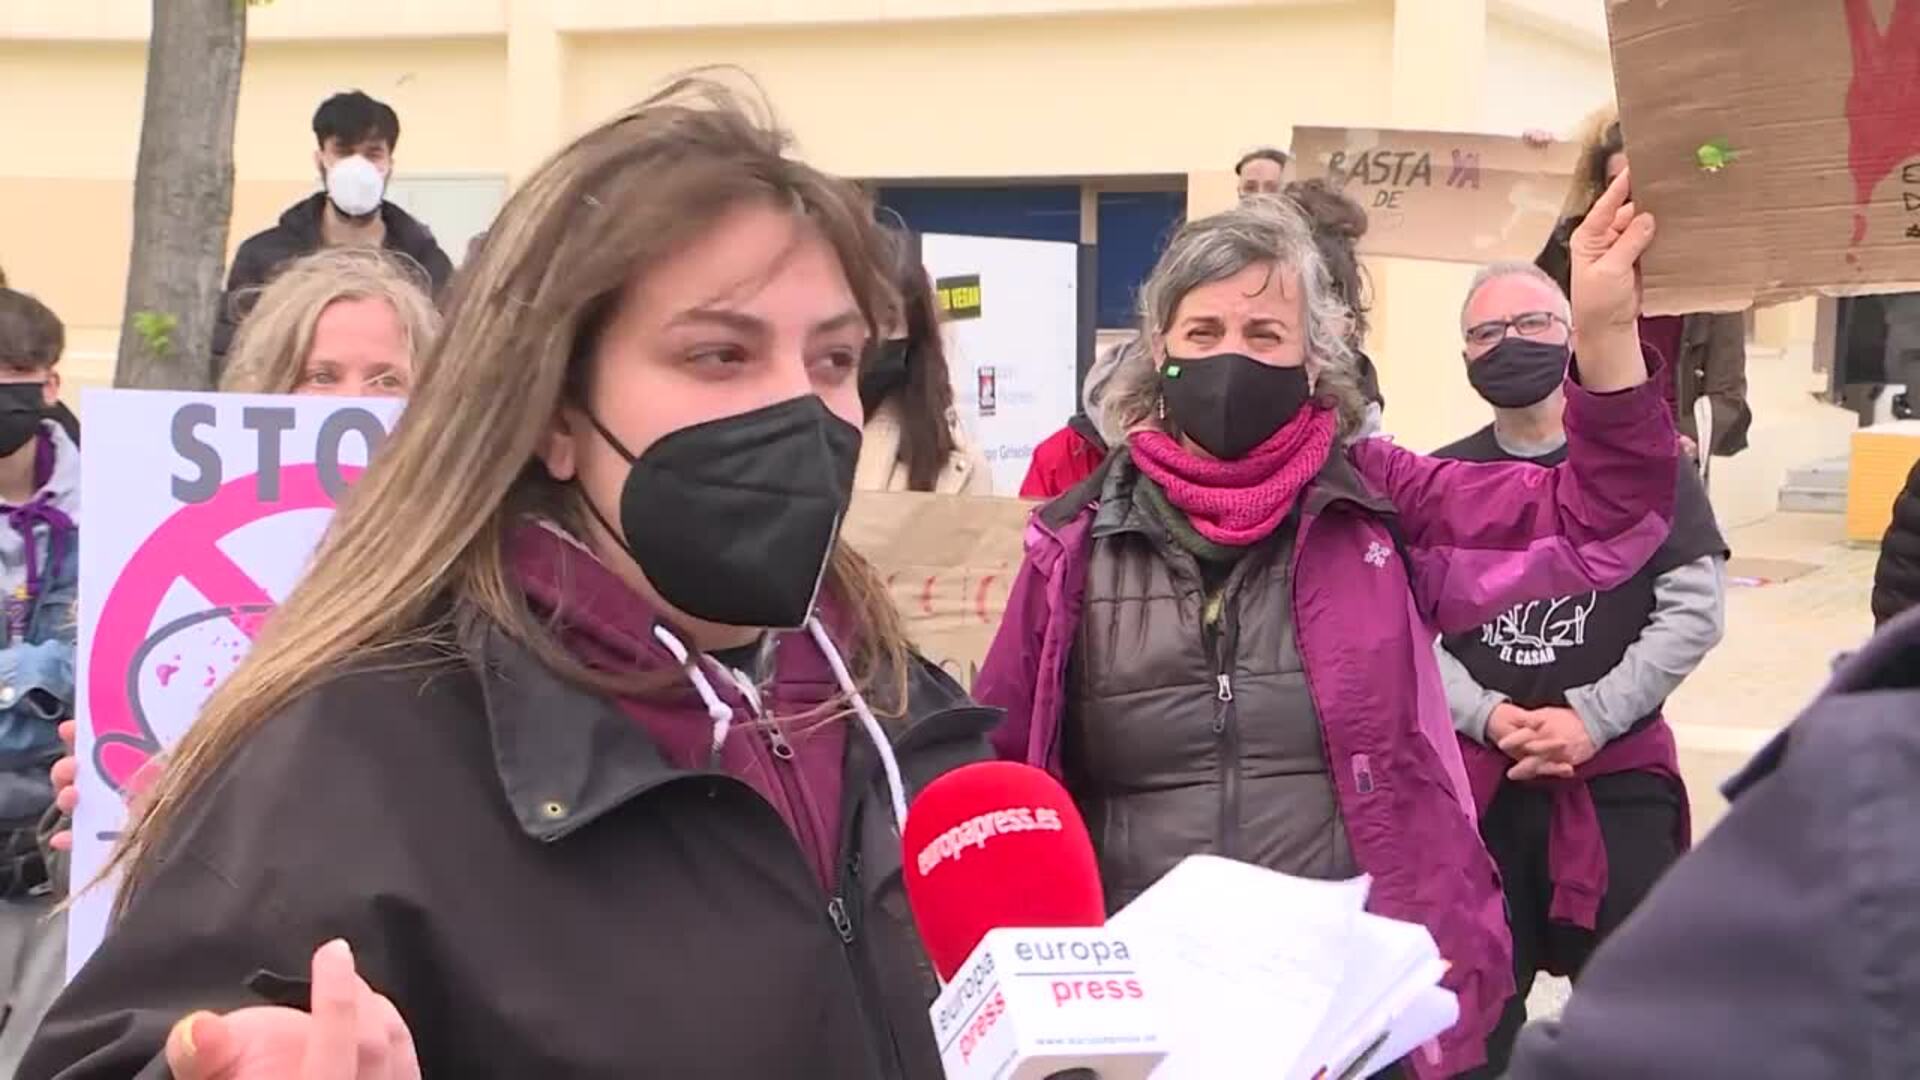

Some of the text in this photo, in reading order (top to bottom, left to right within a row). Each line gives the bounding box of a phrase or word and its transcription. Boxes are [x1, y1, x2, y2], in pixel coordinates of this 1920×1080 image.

[1328, 151, 1432, 187] BASTA
[1371, 189, 1404, 209] DE
[170, 402, 389, 505] STO
[1515, 647, 1556, 665] CASAR
[917, 807, 1062, 876] europapress.es
[1015, 938, 1131, 966] europa
[939, 952, 995, 1031] europa
[1052, 979, 1144, 1008] press
[960, 992, 1005, 1065] press
